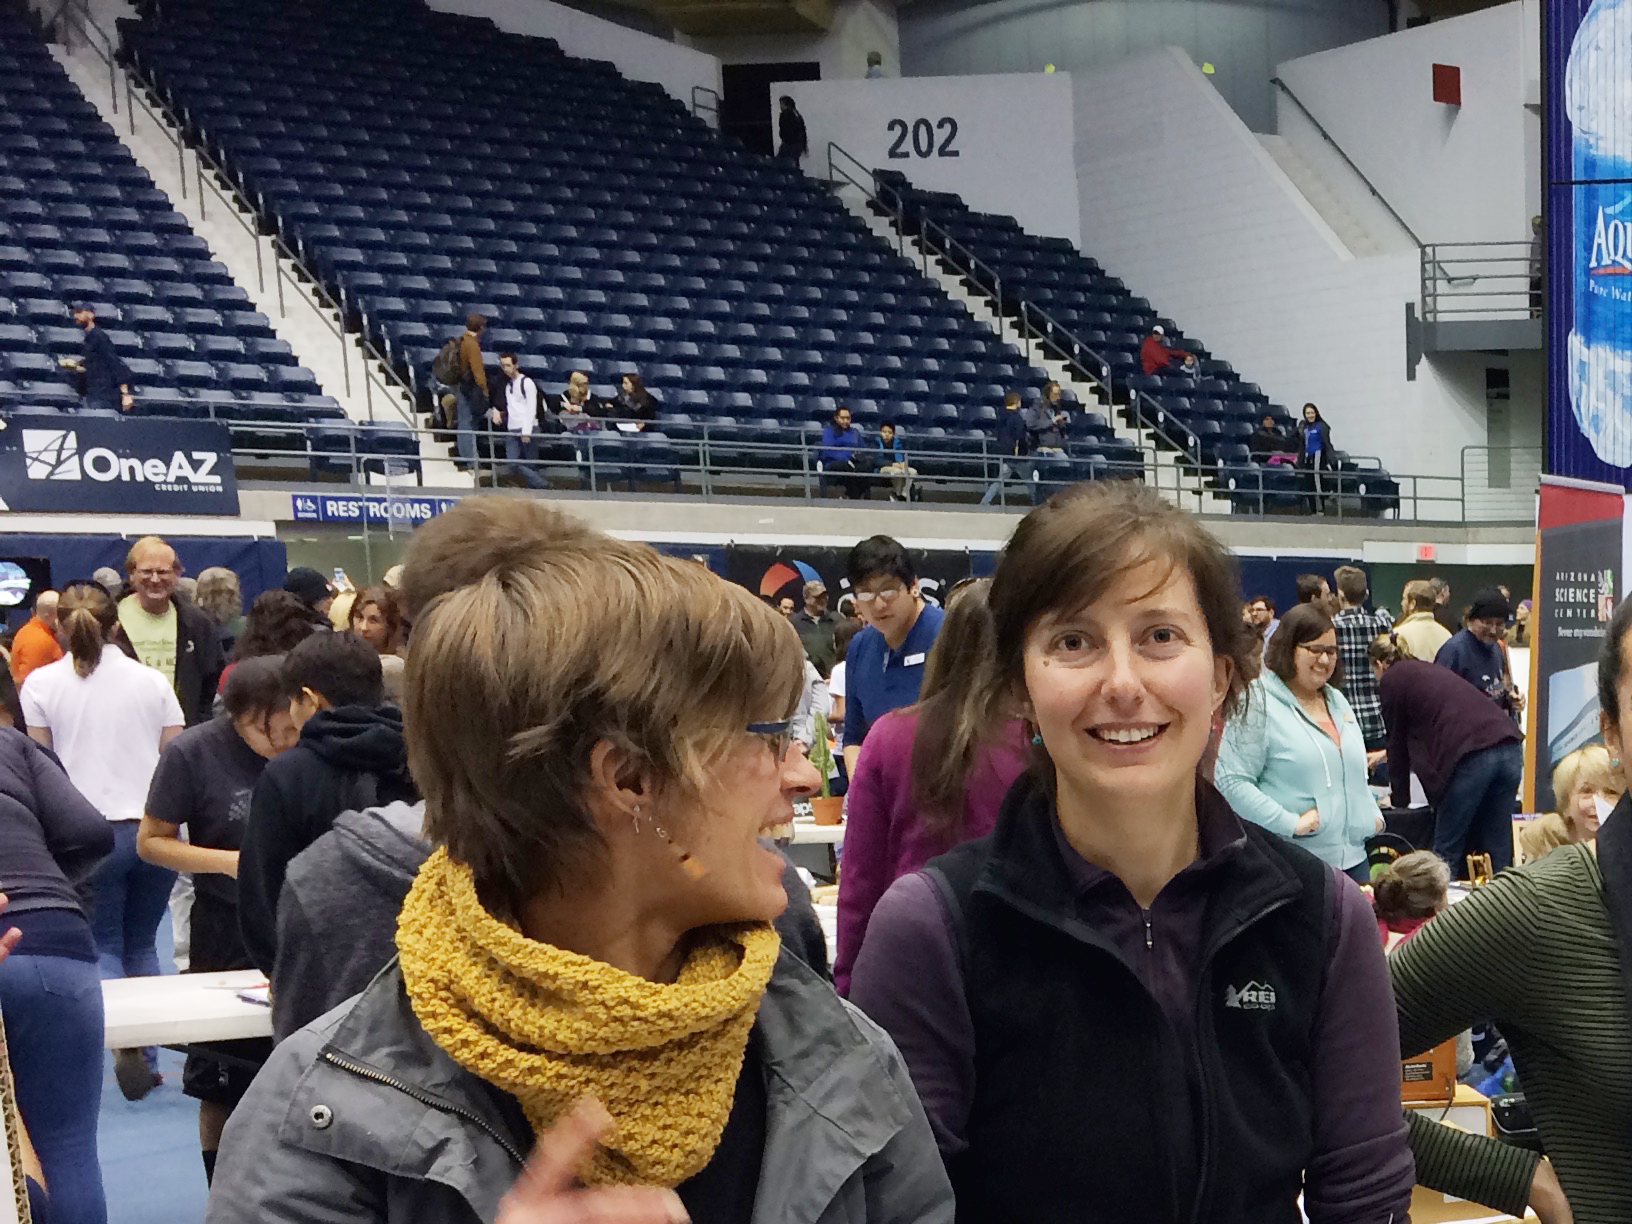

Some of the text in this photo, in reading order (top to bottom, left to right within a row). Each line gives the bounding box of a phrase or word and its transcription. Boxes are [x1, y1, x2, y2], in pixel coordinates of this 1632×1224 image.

[887, 116, 960, 159] 202
[83, 447, 222, 484] OneAZ
[154, 483, 223, 493] CREDIT UNION
[326, 500, 433, 519] RESTROOMS
[1555, 587, 1596, 603] SCIENCE
[1243, 991, 1276, 1004] REI
